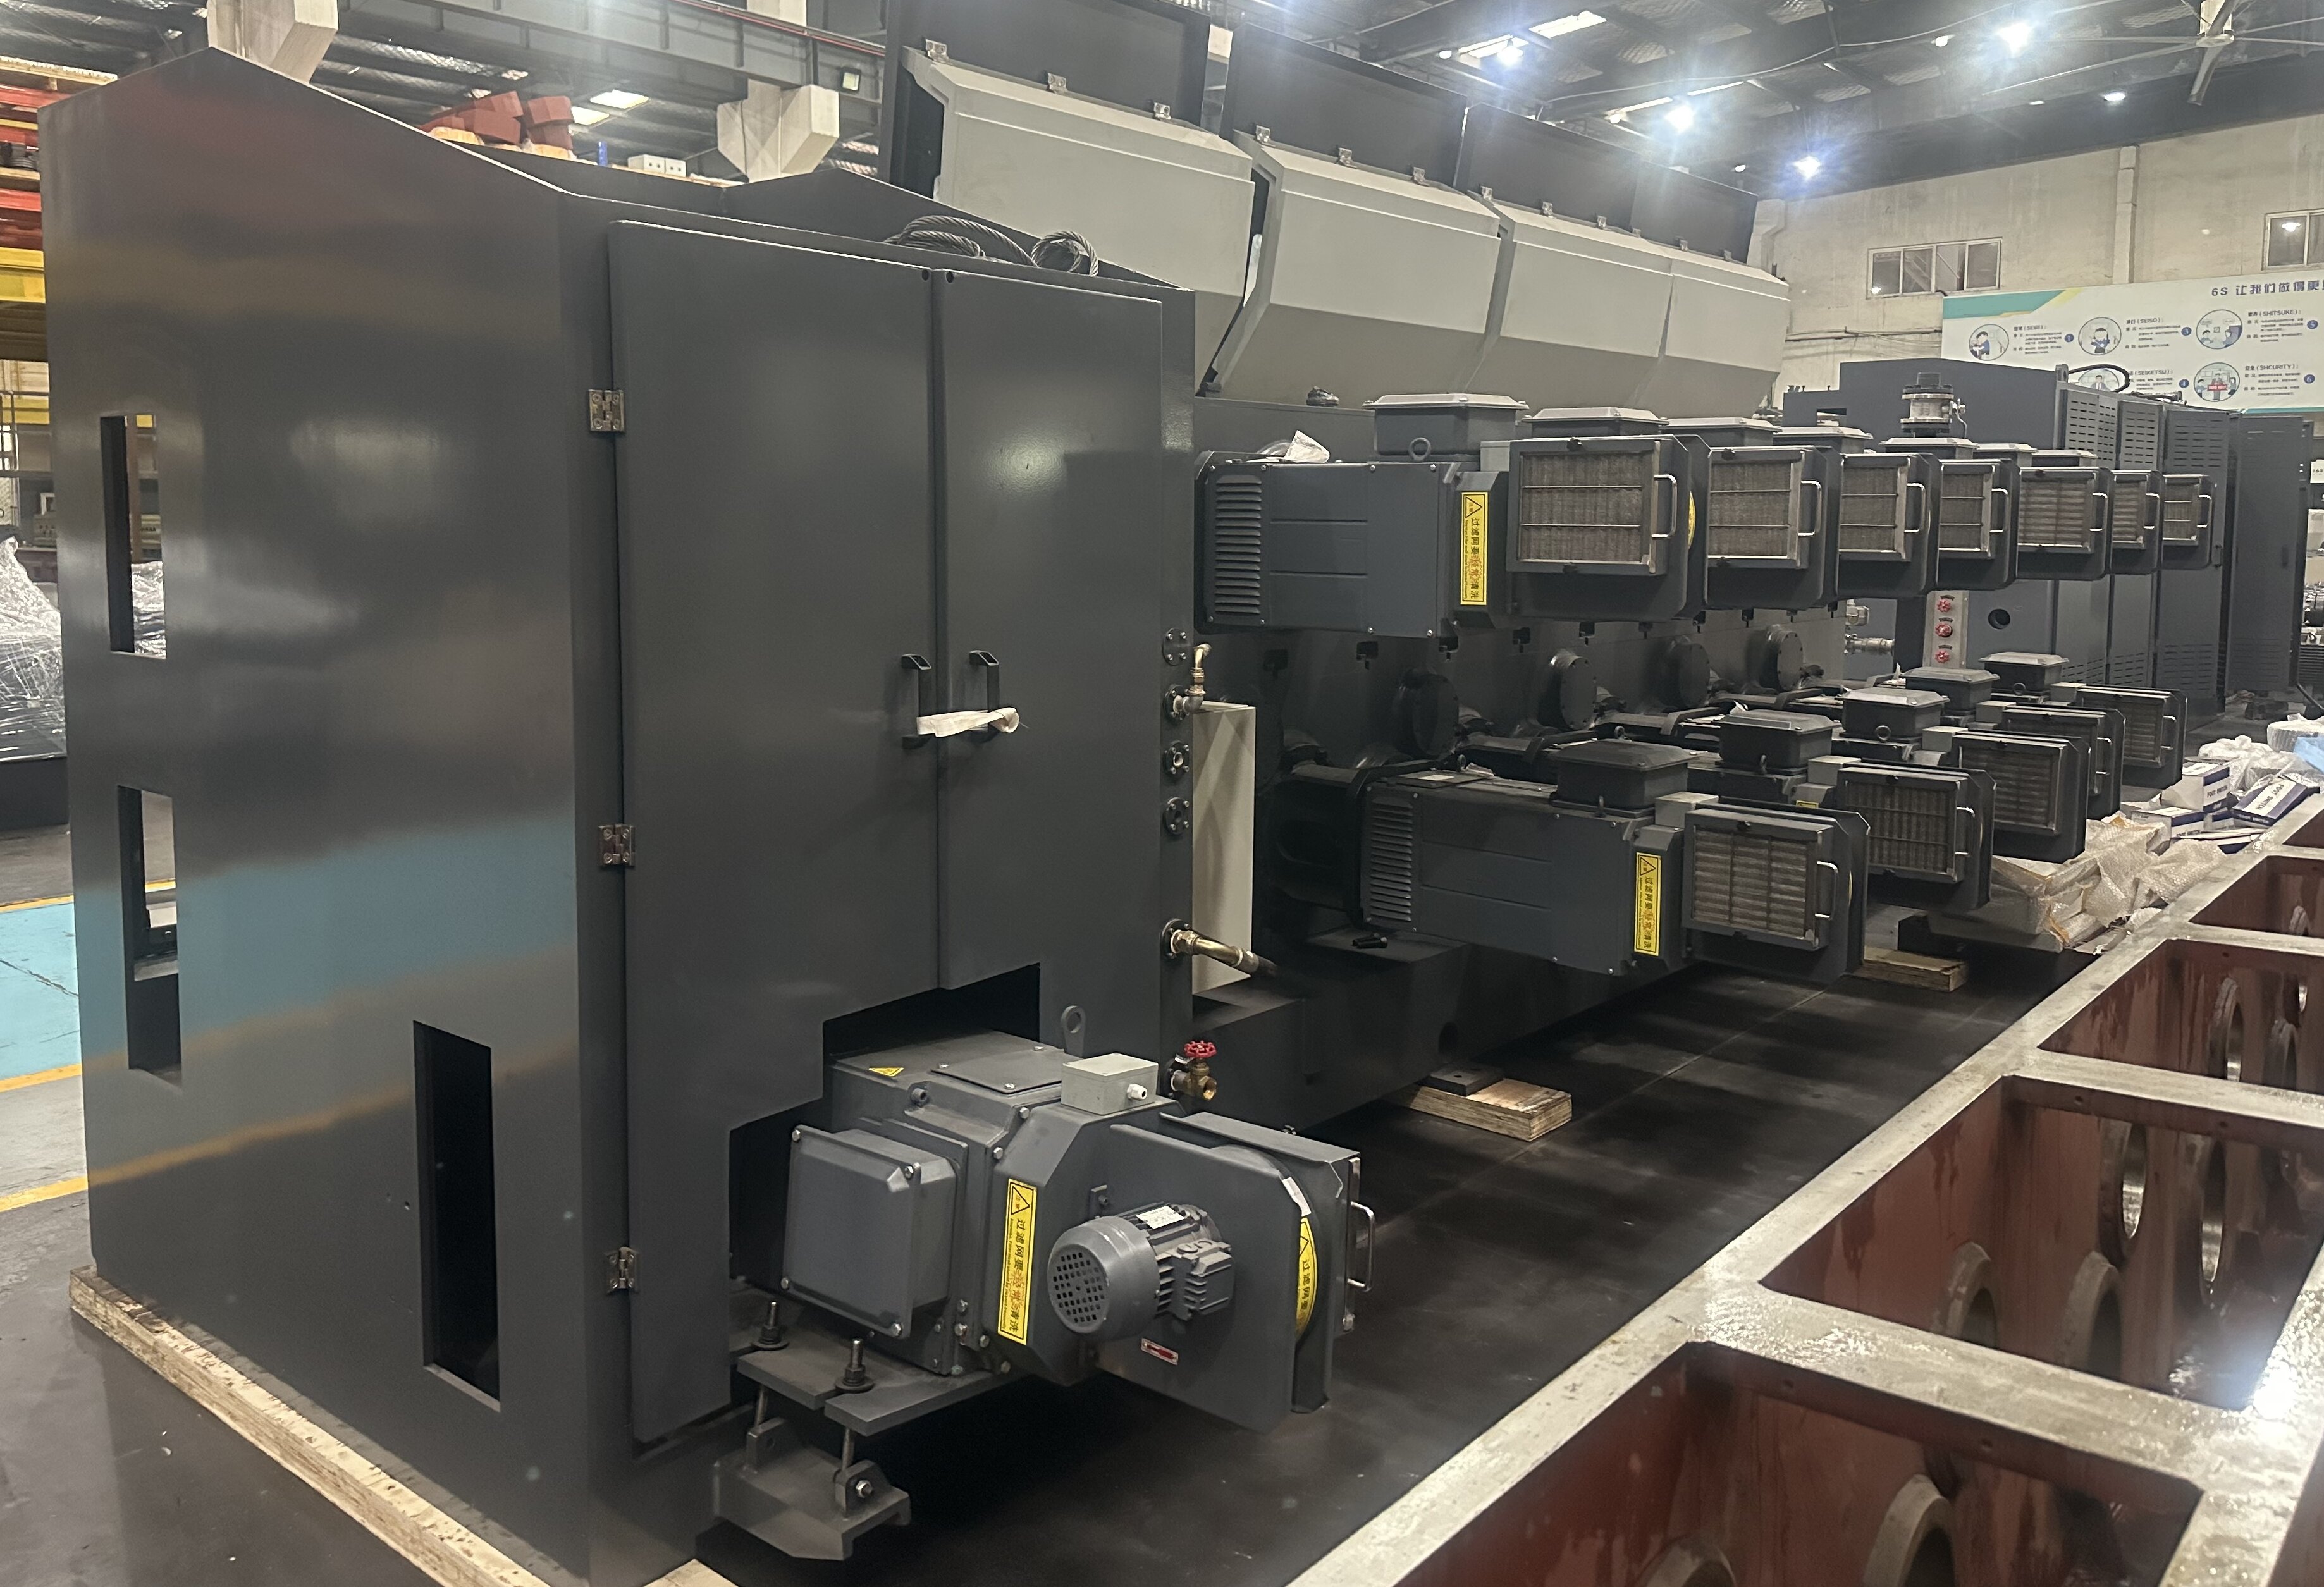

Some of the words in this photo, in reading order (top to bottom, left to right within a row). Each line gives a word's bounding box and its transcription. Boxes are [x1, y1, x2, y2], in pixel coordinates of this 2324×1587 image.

[2211, 287, 2228, 296] 6S
[2235, 280, 2324, 296] 让我们做得更
[1009, 1218, 1026, 1333] 过滤网要经常清洗
